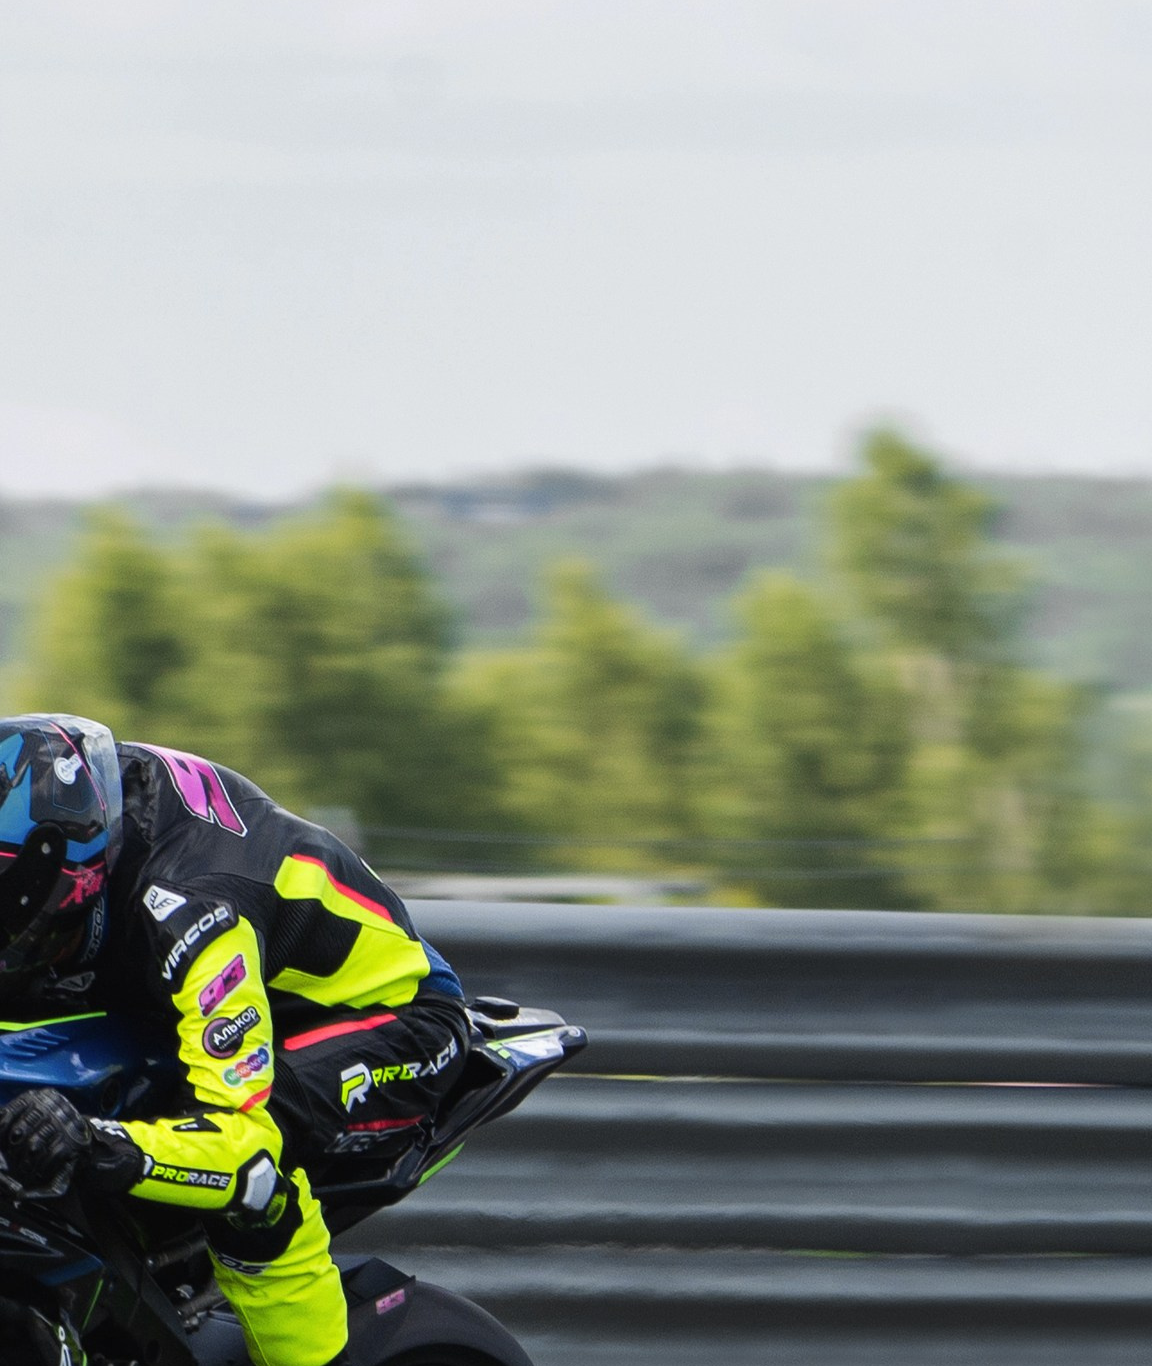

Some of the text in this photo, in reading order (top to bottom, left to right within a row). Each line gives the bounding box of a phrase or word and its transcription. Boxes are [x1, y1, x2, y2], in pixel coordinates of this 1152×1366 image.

[161, 906, 229, 981] VIRCOS
[198, 953, 247, 1017] 93
[212, 1006, 257, 1046] Алькор
[151, 1164, 231, 1188] PRORACE
